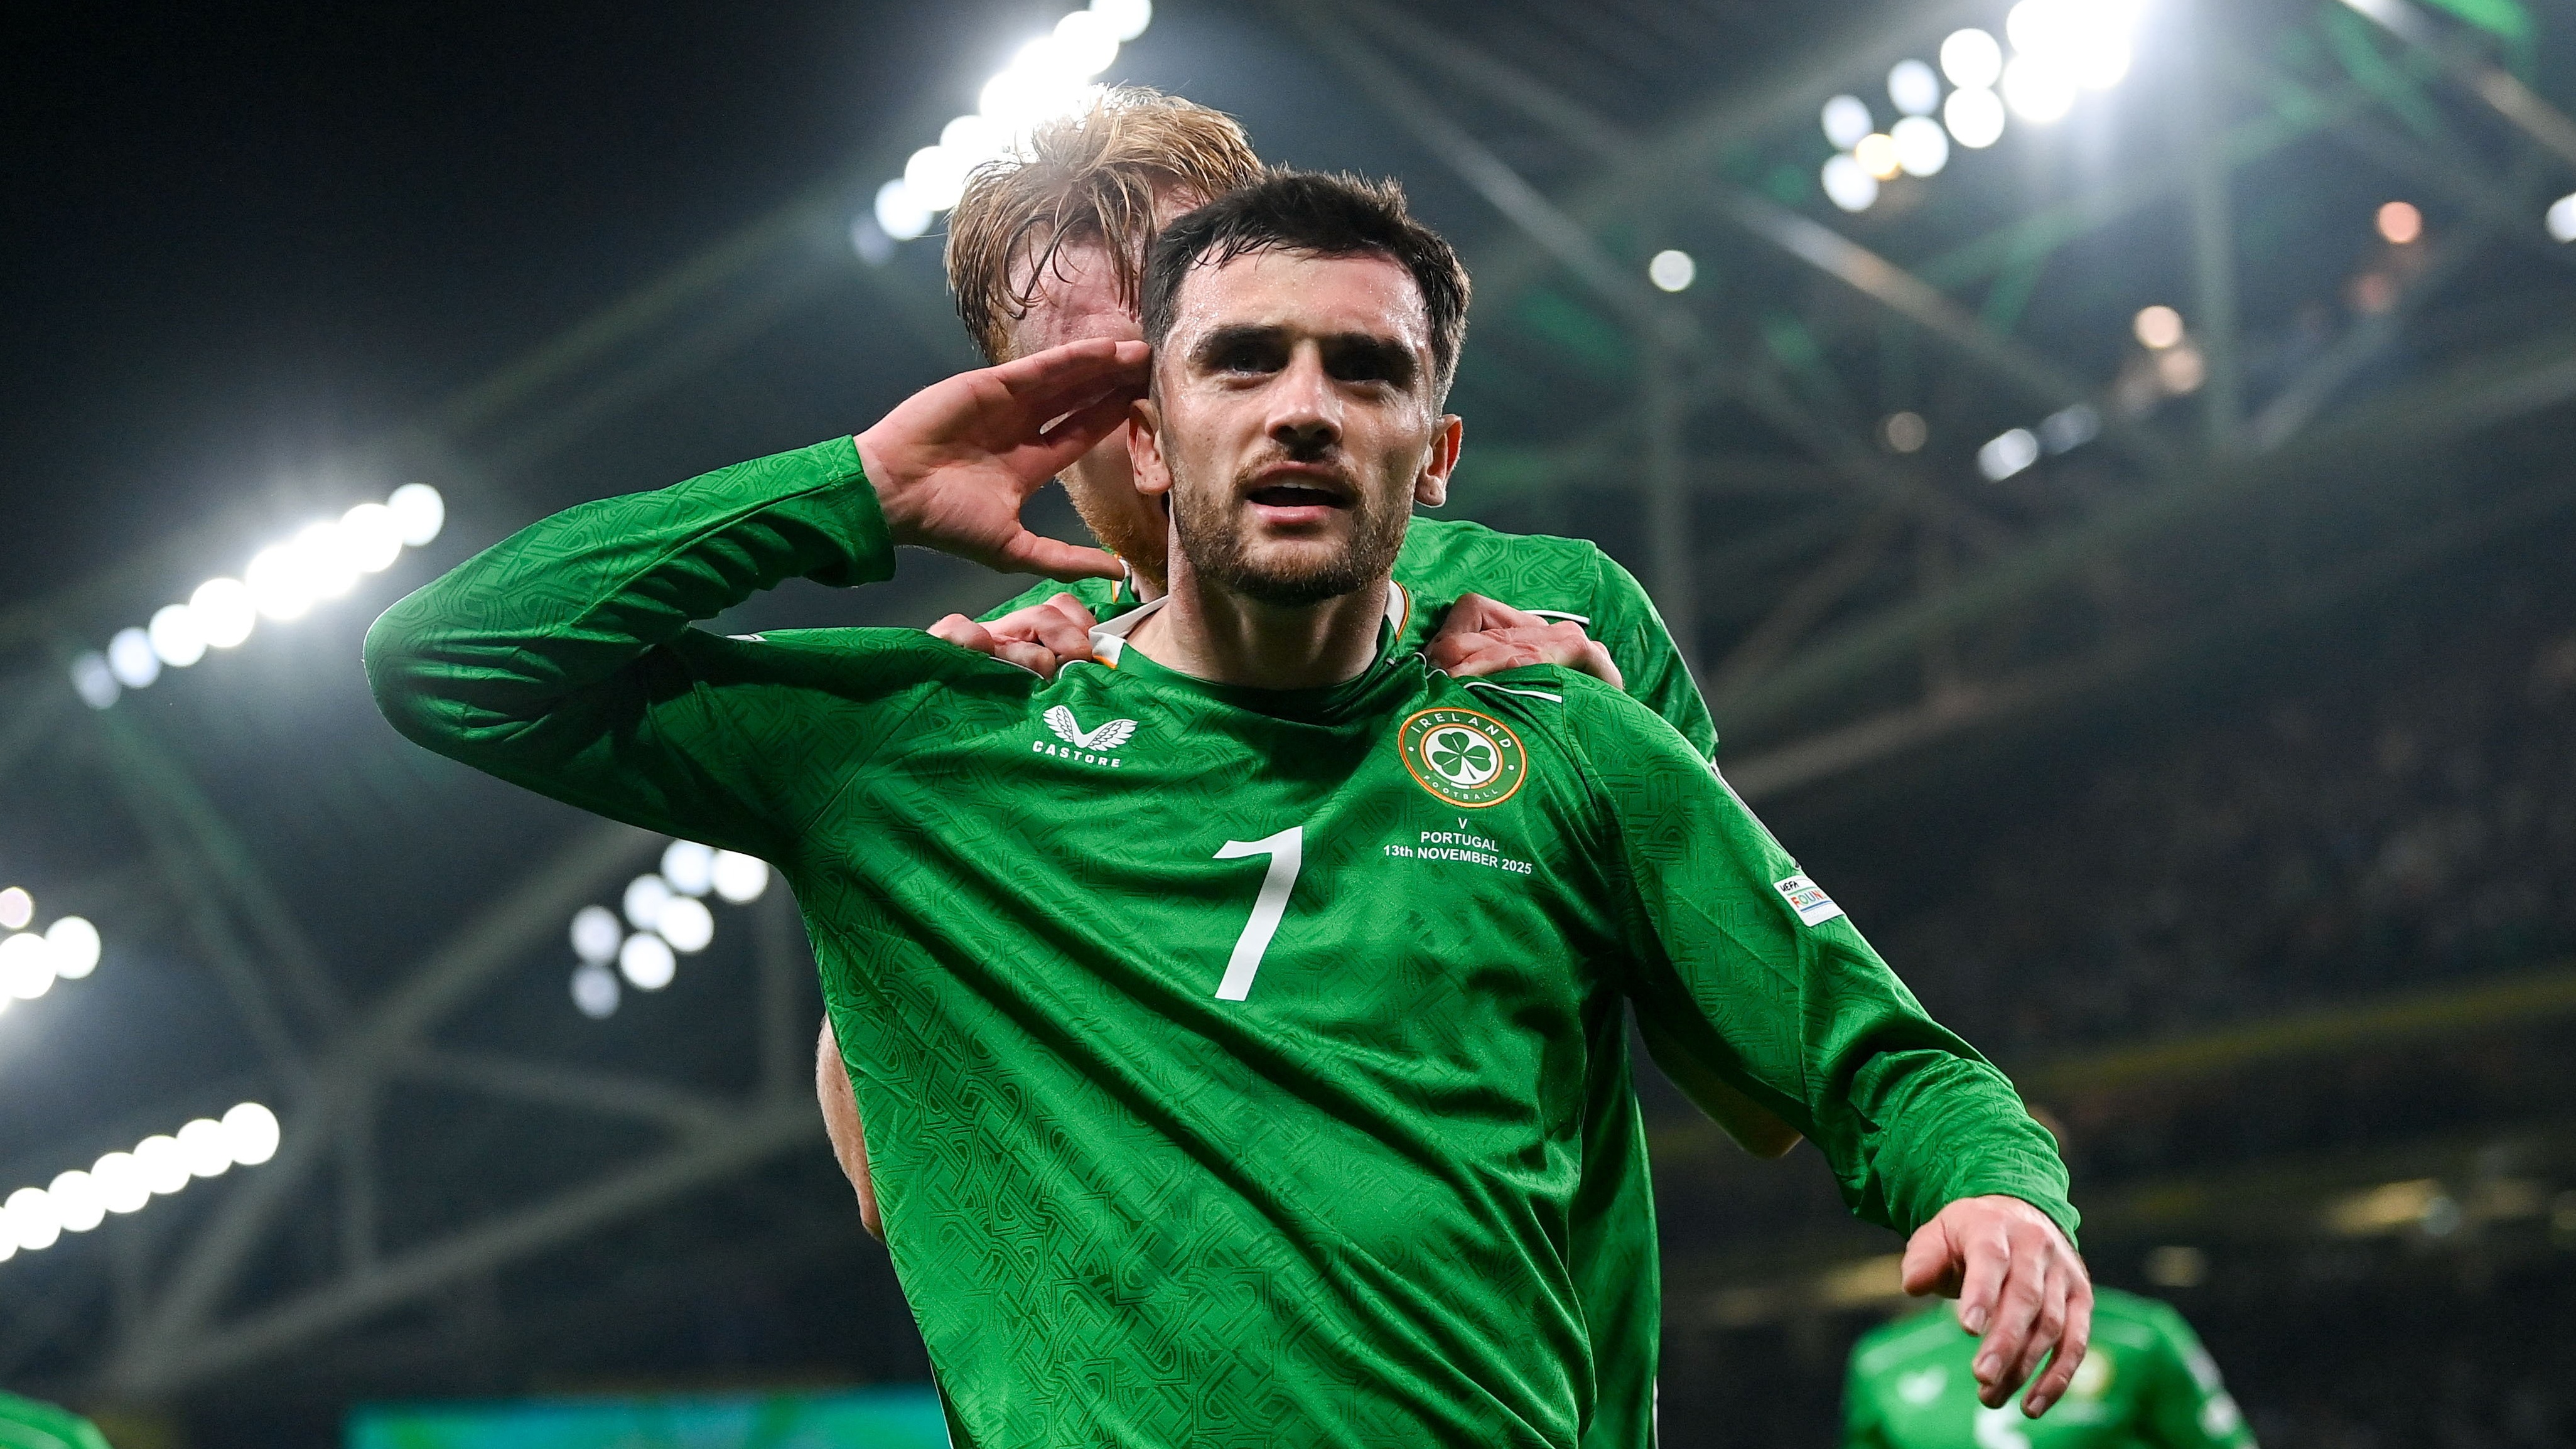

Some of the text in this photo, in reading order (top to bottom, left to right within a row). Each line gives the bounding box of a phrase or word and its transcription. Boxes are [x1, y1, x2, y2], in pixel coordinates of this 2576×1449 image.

[1410, 713, 1512, 748] IRELAND
[1032, 740, 1121, 768] CASTORE
[1423, 775, 1498, 800] FOOTBALL
[1458, 817, 1468, 829] V
[1421, 831, 1499, 852] PORTUGAL
[1383, 845, 1533, 875] 13th NOVEMBER 2025
[1779, 881, 1799, 892] UEFA
[1791, 890, 1828, 908] FOUN
[1212, 826, 1303, 1001] 7
